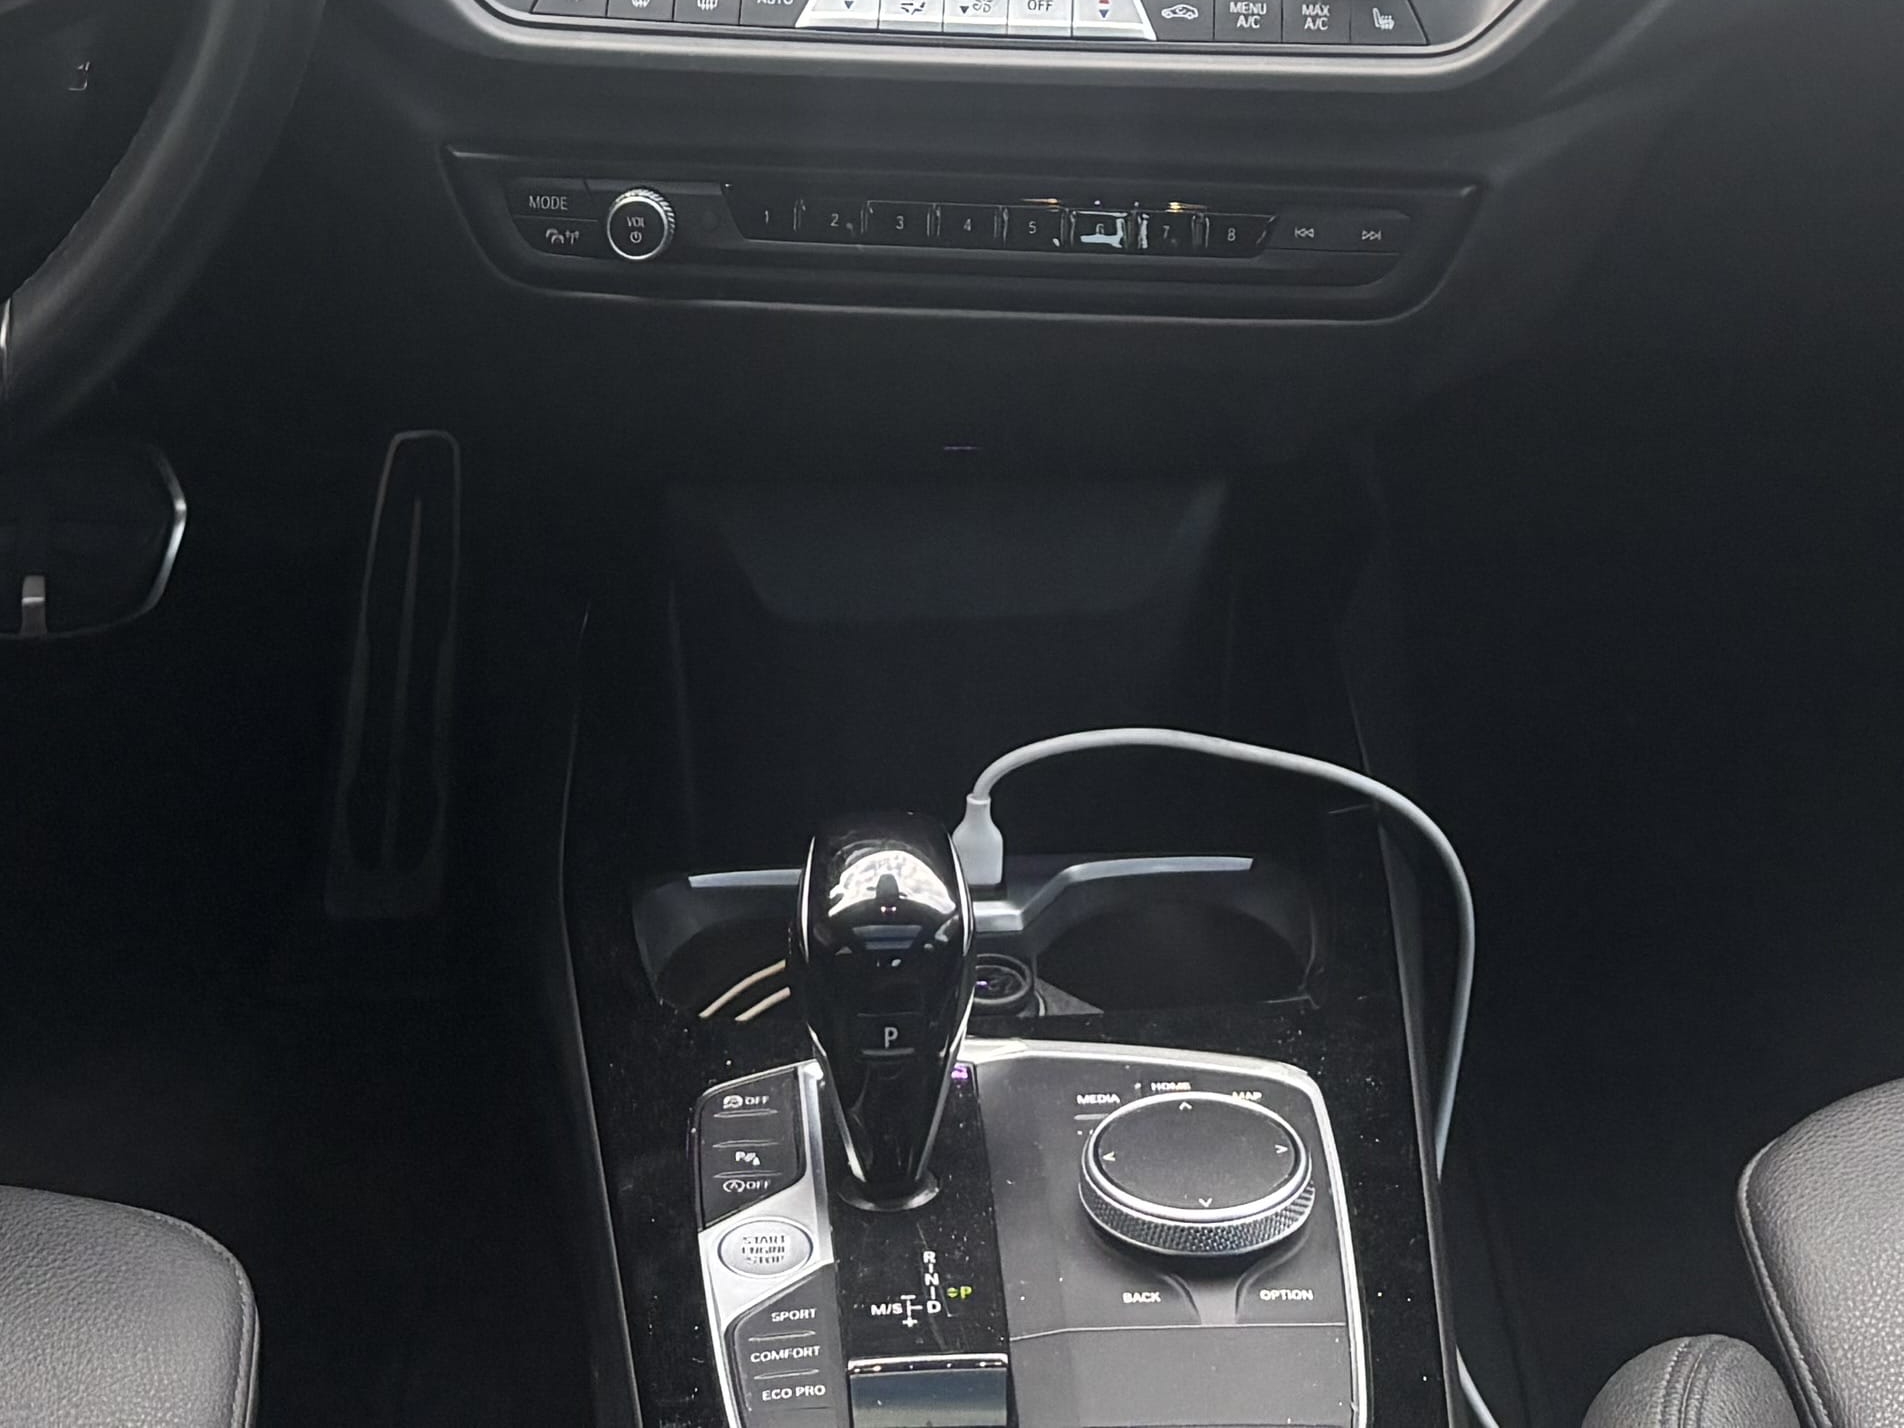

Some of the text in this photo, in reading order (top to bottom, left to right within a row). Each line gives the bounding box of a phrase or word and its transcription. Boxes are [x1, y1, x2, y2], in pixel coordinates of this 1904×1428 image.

[1230, 1, 1267, 16] MENU
[1237, 14, 1260, 30] A/C
[1304, 16, 1329, 31] A/C
[528, 195, 568, 211] MODE
[763, 210, 769, 224] 1
[830, 213, 840, 227] 2
[895, 216, 905, 230] 3
[963, 218, 972, 233] 4
[1028, 221, 1037, 235] 5
[1162, 225, 1171, 240] 7
[1227, 228, 1237, 242] 8
[884, 1027, 898, 1048] P
[1151, 1082, 1192, 1091] HOME
[745, 1095, 769, 1106] OFF
[1077, 1094, 1120, 1105] MEDIA
[746, 1180, 771, 1191] OFF
[923, 1251, 936, 1264] R
[924, 1273, 939, 1286] N
[960, 1286, 973, 1298] P
[1122, 1290, 1161, 1303] BACK
[1260, 1289, 1313, 1302] OPTION
[871, 1303, 903, 1316] M/S
[927, 1301, 941, 1314] D
[771, 1308, 817, 1323] SPORT
[750, 1346, 821, 1363] COMFORT
[762, 1385, 826, 1401] ECO PRO
